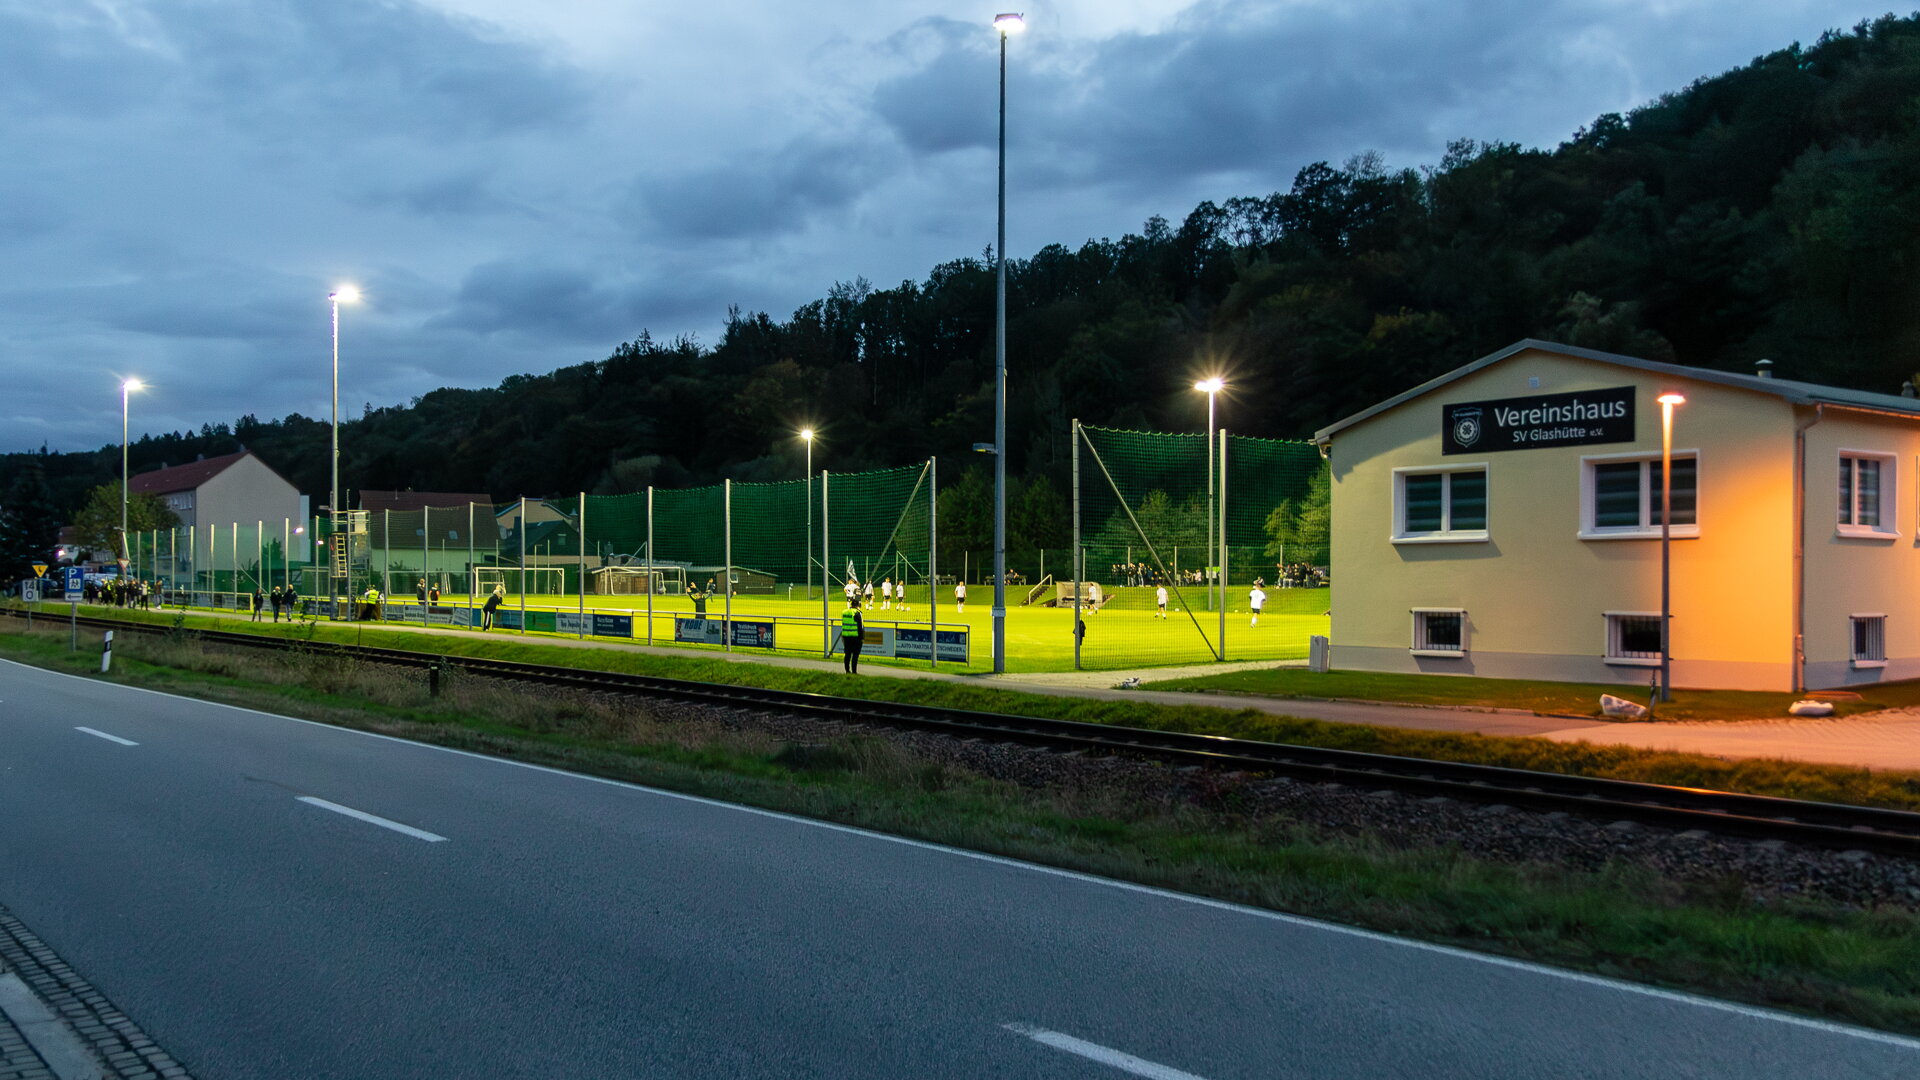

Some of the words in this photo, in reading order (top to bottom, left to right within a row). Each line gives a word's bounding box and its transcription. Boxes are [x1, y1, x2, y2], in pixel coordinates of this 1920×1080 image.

[1494, 399, 1626, 427] Vereinshaus
[1512, 431, 1529, 443] SV
[1530, 427, 1586, 441] Glashütte
[1589, 428, 1604, 437] e.V.
[69, 568, 77, 579] P
